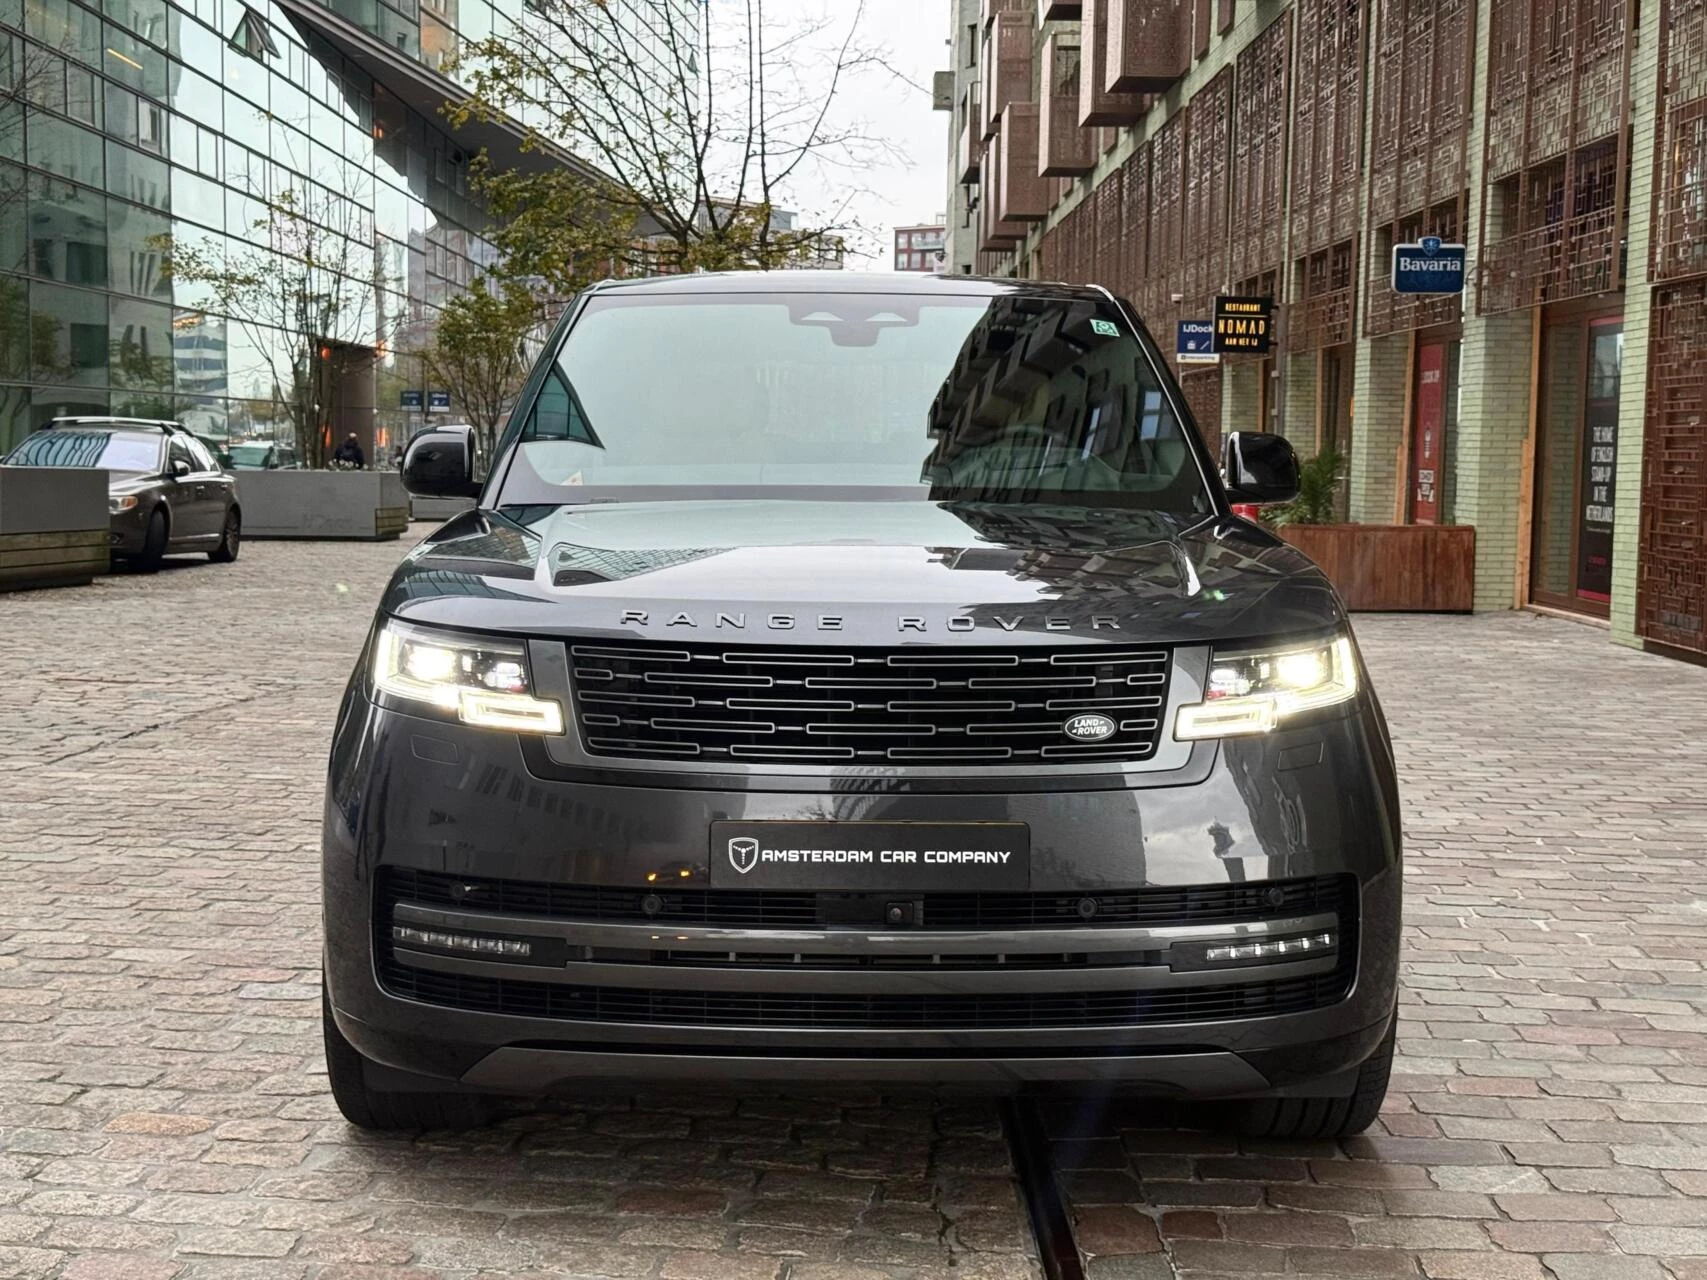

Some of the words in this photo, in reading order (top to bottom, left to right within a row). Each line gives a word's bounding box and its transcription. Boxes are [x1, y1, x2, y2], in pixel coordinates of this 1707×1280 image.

[1400, 256, 1461, 271] Bavaria
[1225, 303, 1261, 312] RESTAURANT
[1218, 319, 1265, 335] NOMAD
[620, 609, 843, 630] RANGE
[898, 615, 1121, 632] ROVER
[1074, 719, 1099, 728] LAND
[1077, 726, 1108, 735] ROVER
[761, 850, 873, 863] AMSTERDAM
[880, 850, 917, 863] CAR
[924, 851, 1011, 864] COMPANY
